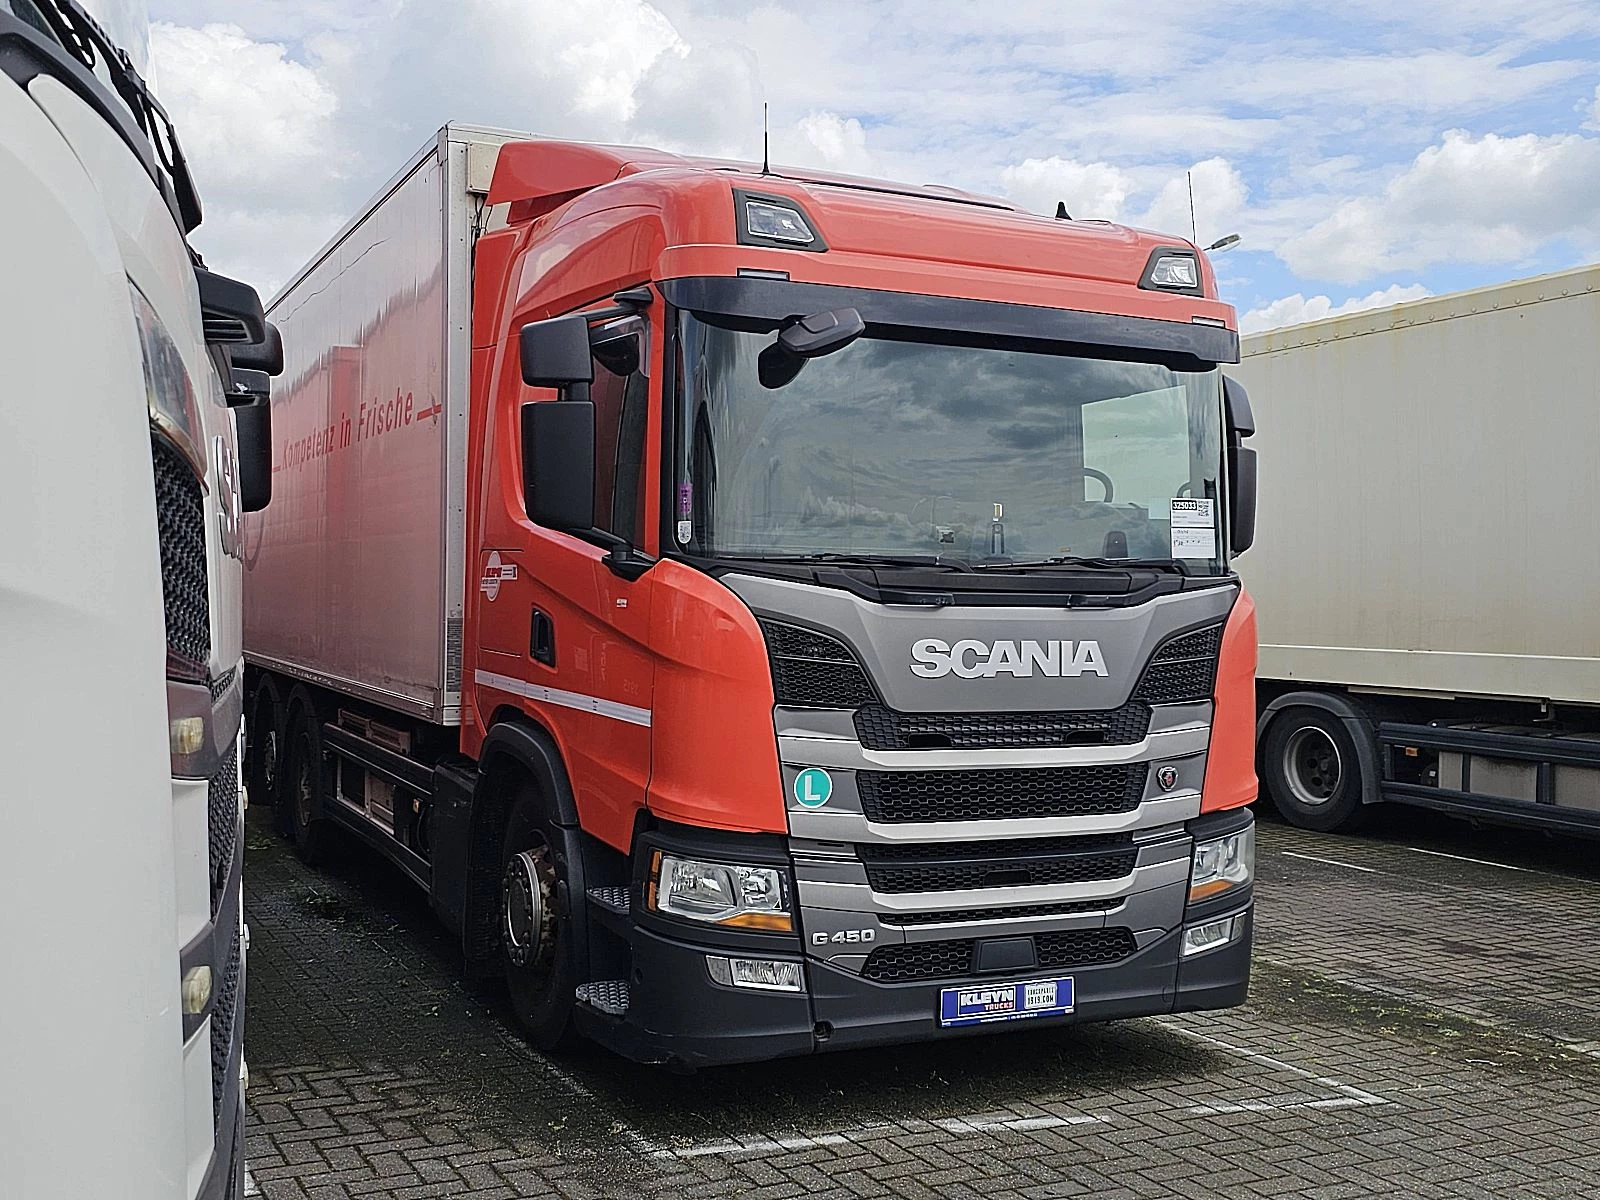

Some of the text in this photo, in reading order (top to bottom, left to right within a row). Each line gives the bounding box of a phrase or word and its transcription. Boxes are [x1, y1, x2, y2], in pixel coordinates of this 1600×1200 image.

[283, 387, 413, 472] Kompetenz in Frische
[1172, 501, 1197, 510] 325033
[909, 638, 1109, 679] SCANIA
[804, 774, 821, 801] L
[812, 929, 876, 946] G 450
[960, 989, 1014, 1006] KLEYN
[984, 1002, 1014, 1011] TRUCKS
